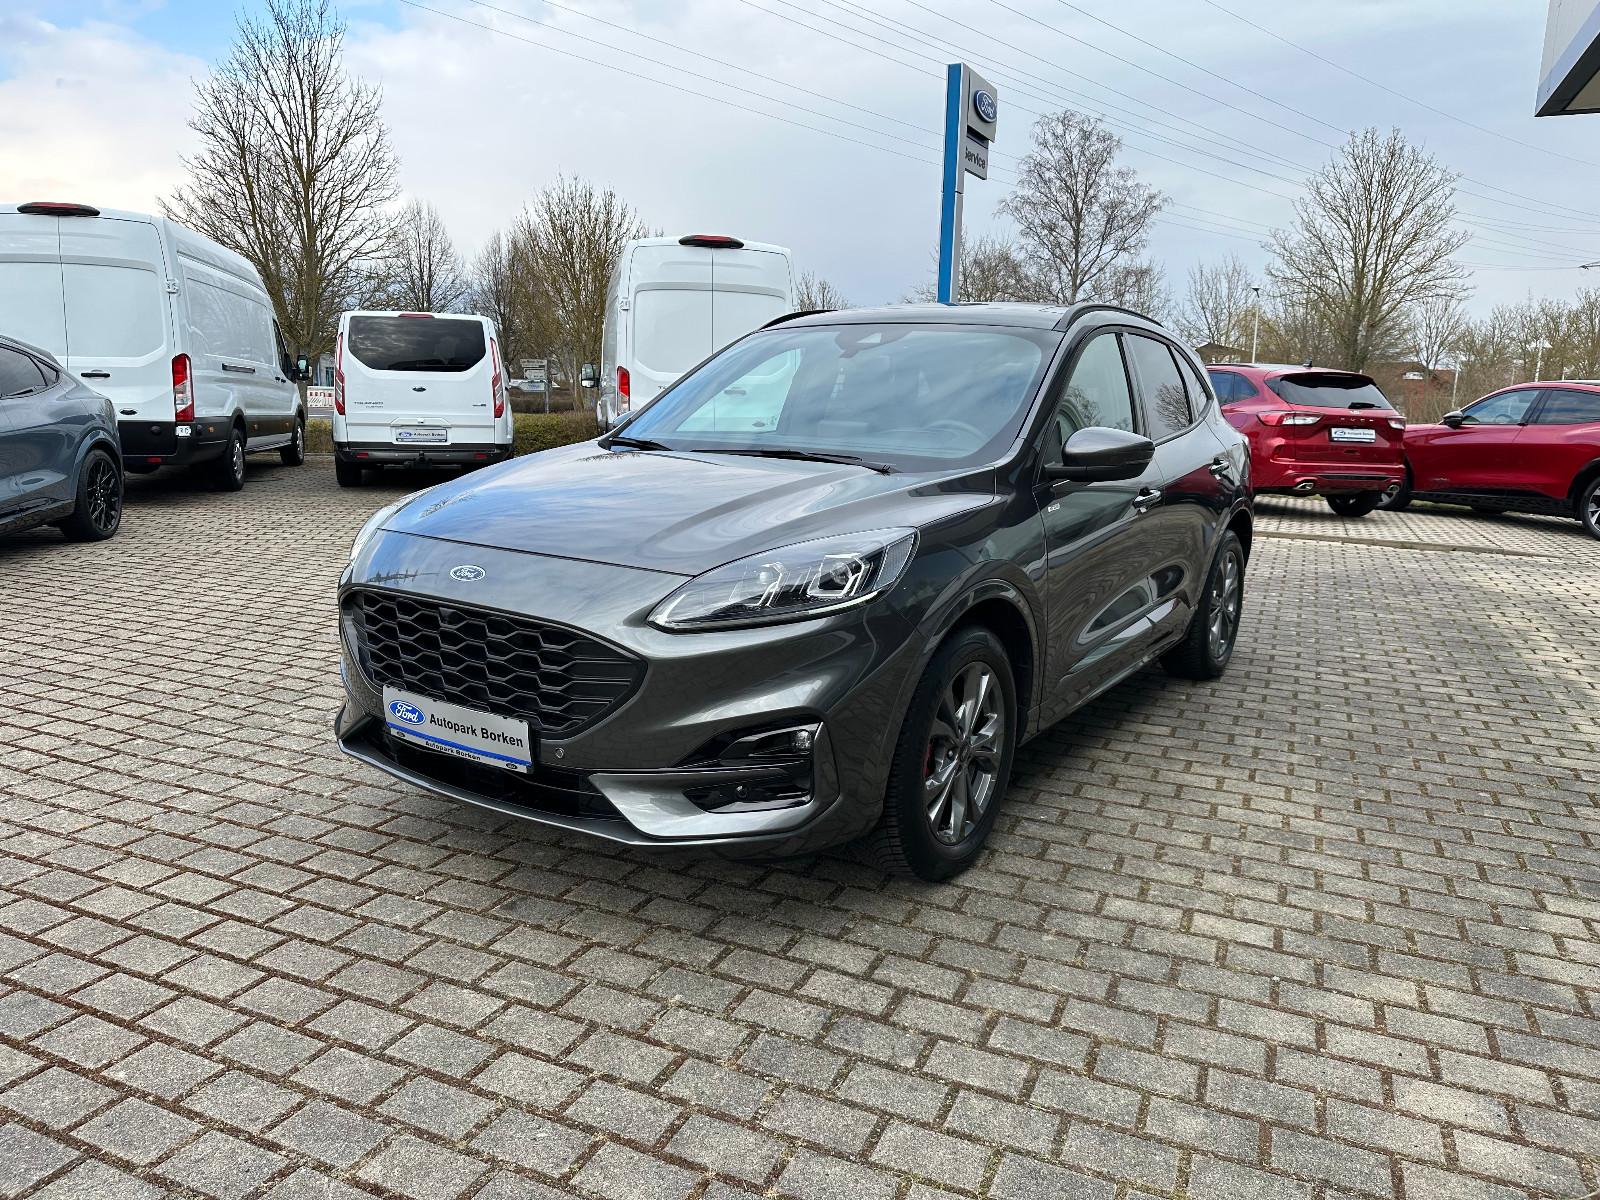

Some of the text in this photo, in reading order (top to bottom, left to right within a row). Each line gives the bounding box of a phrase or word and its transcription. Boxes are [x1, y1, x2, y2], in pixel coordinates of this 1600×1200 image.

[395, 702, 419, 722] Ford
[429, 713, 524, 748] Autopark Borken
[425, 740, 481, 761] Autopark Borken
